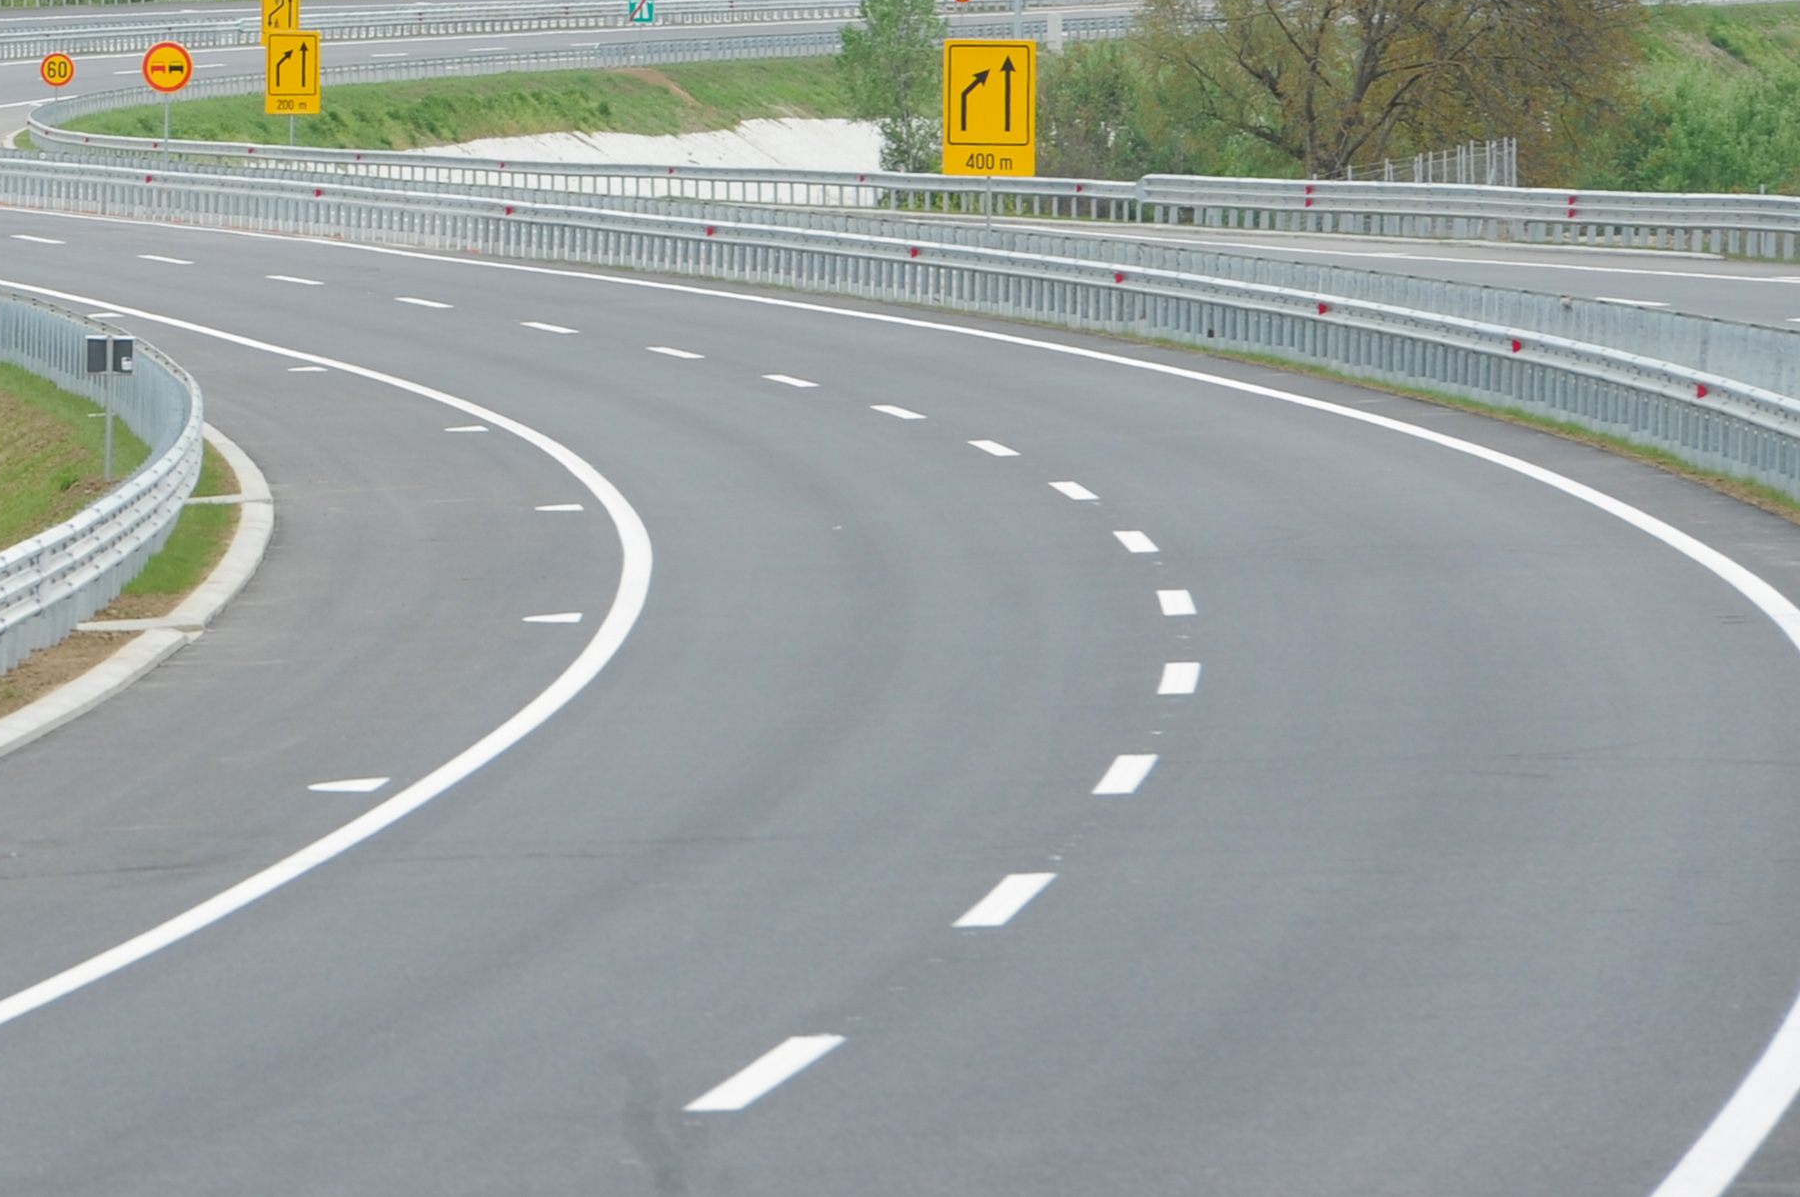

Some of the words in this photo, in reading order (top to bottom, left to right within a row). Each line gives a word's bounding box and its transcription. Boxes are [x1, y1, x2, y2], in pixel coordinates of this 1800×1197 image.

[47, 61, 67, 78] 60
[277, 99, 294, 110] 200
[299, 102, 307, 110] m
[966, 153, 995, 170] 400
[1000, 157, 1012, 170] m
